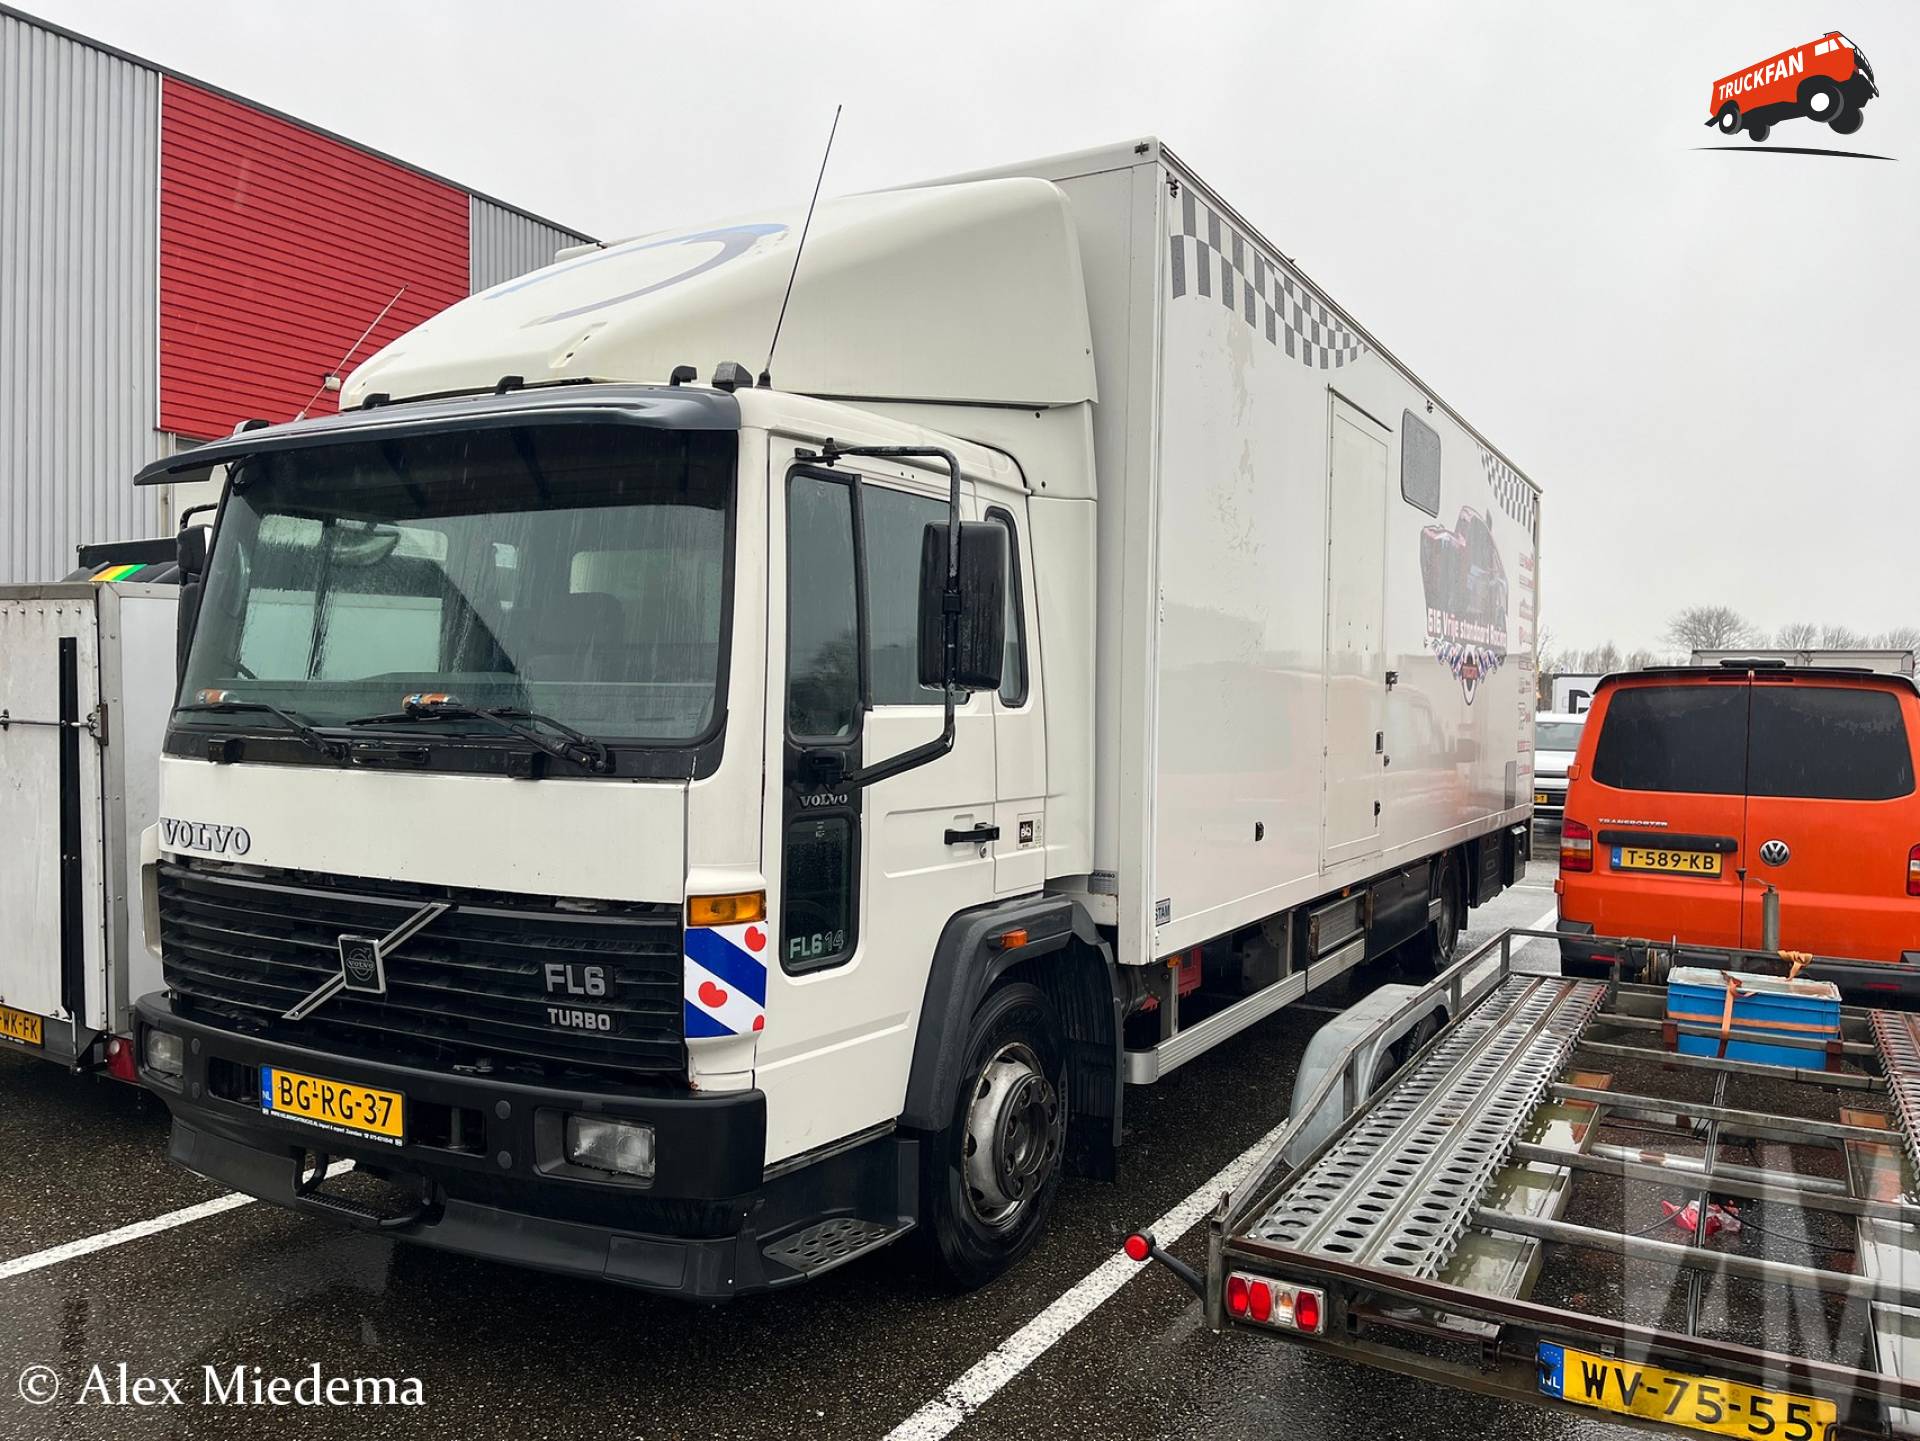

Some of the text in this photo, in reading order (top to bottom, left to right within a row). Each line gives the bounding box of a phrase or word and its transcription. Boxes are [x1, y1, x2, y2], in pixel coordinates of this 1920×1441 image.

[800, 793, 848, 808] VOLVO
[160, 817, 251, 856] VOLVO
[1598, 818, 1668, 828] TRANSPORTER
[1627, 850, 1715, 870] T-589-KB
[790, 929, 844, 960] FL6 14
[348, 960, 375, 969] VOLVO
[544, 963, 606, 996] FL6
[547, 1008, 611, 1031] TURBO
[280, 1075, 393, 1127] BG-RG-37
[1581, 1360, 1814, 1441] WV-75-55
